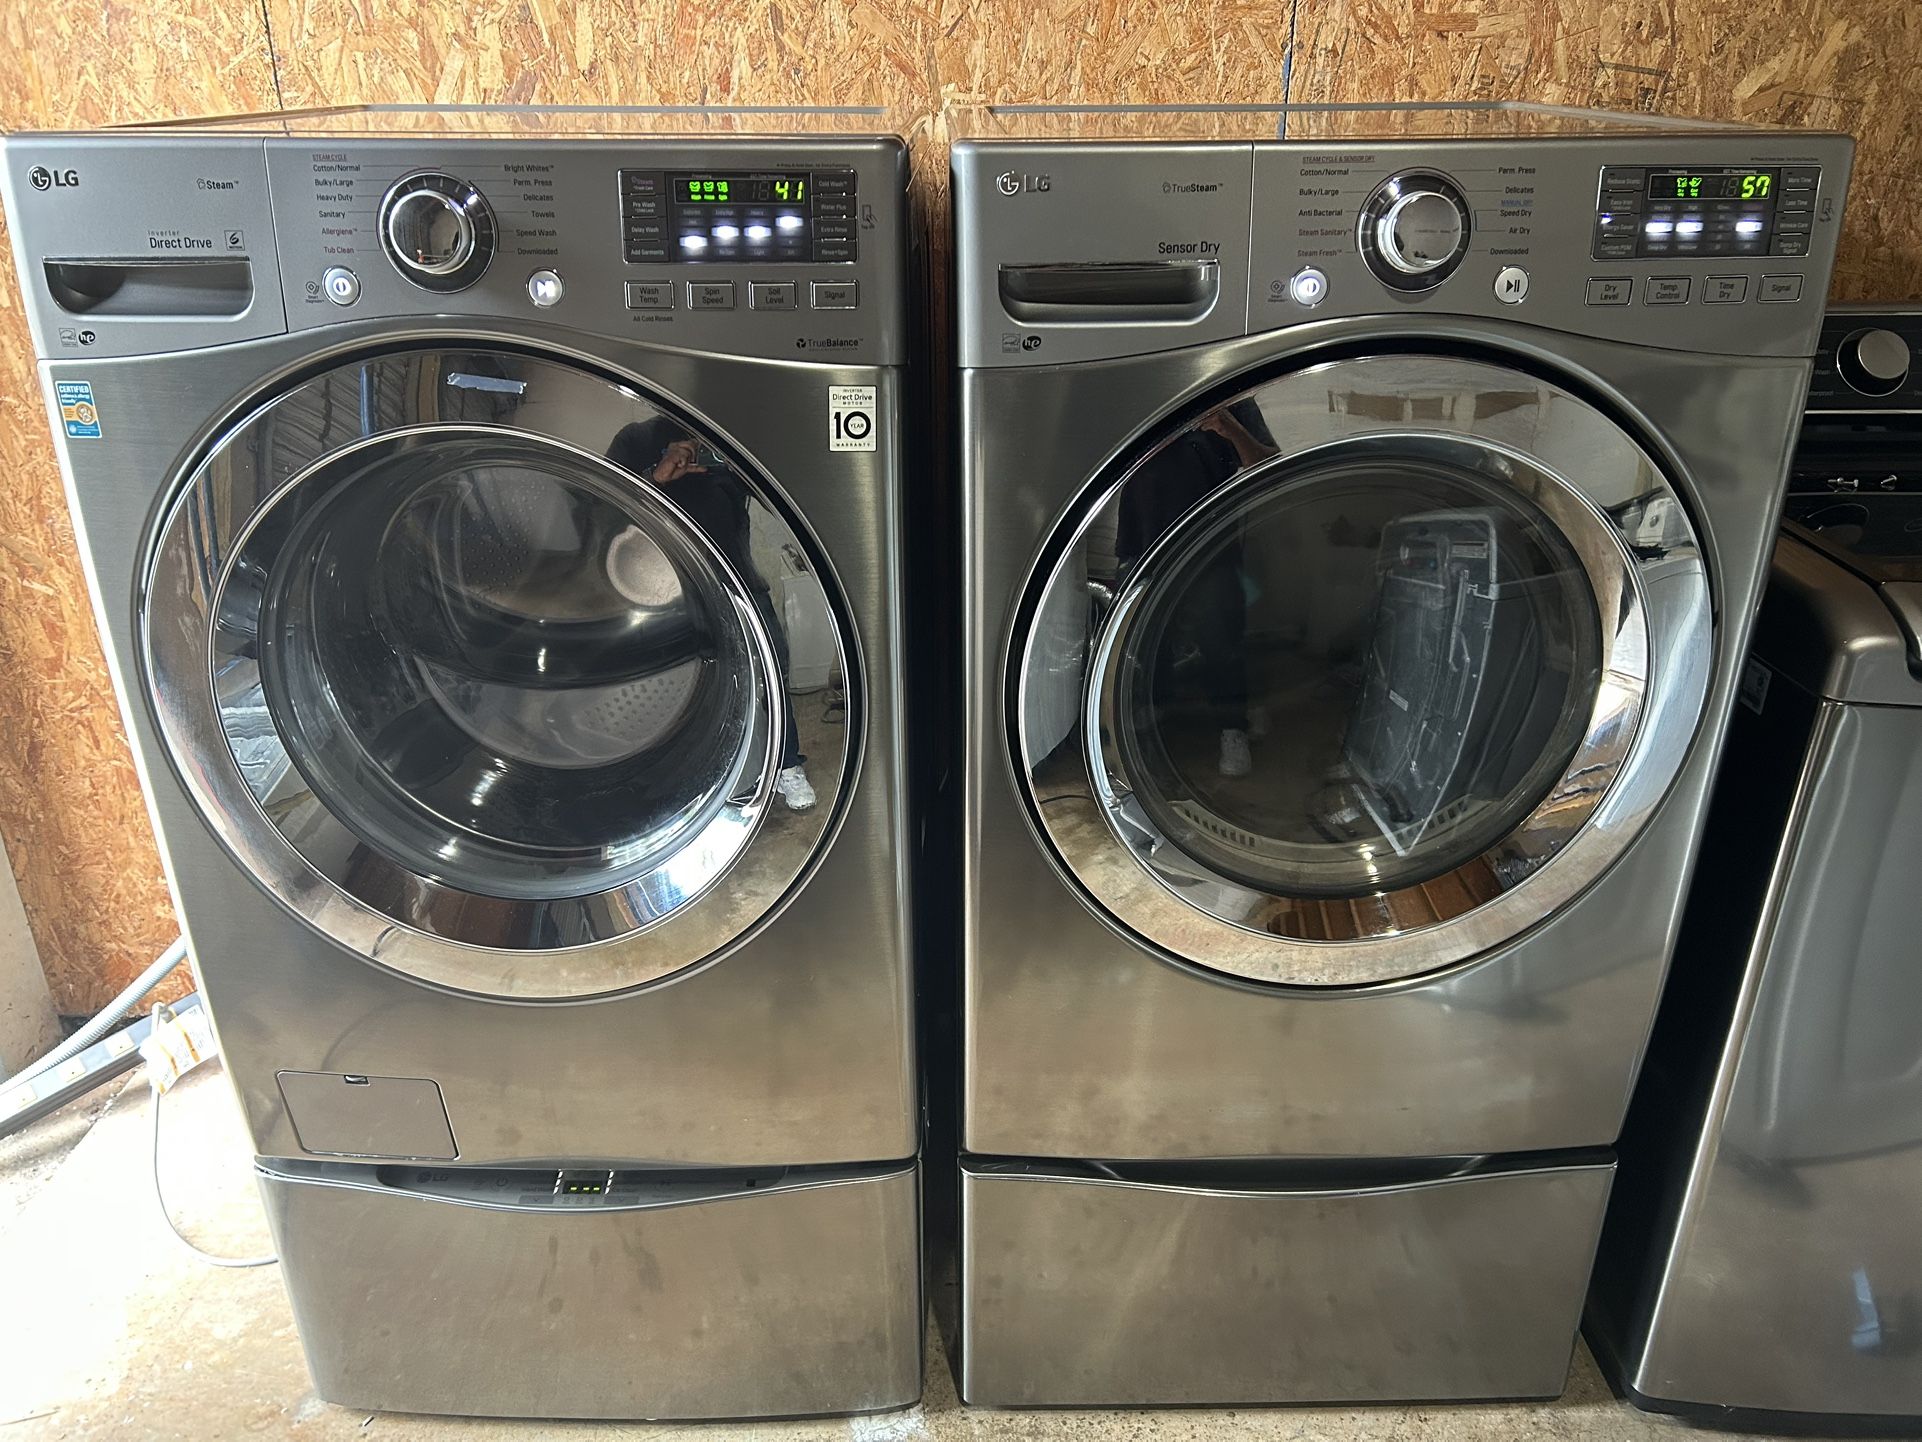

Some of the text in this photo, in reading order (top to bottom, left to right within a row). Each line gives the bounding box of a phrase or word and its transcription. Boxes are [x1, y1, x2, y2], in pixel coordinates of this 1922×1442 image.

[313, 164, 361, 173] Cotton/Normal
[504, 164, 524, 173] Bright
[1300, 168, 1349, 176] Cotton/Normal
[54, 169, 80, 187] LG
[315, 178, 354, 187] Bulky/Large
[533, 178, 553, 187] Press
[1024, 175, 1051, 192] LG
[1741, 175, 1771, 198] 57
[775, 181, 803, 200] 41
[1299, 188, 1340, 196] Bulky/Large
[1505, 186, 1534, 194] Delicates
[316, 193, 353, 202] Heavy Duty
[523, 194, 554, 202] Delicates
[318, 210, 346, 219] Sanitary
[531, 210, 556, 218] Towels
[1500, 209, 1532, 218] Speed Dry
[516, 229, 557, 238] Speed Wash
[1298, 229, 1319, 237] Steam
[1519, 227, 1531, 236] Dry
[149, 237, 213, 249] Direct Drive
[323, 246, 355, 254] Tub Clean
[1158, 241, 1220, 255] Sensor Dry
[1490, 248, 1529, 256] Downloaded
[1297, 249, 1318, 257] Steam
[1605, 284, 1617, 293] Dry
[1660, 283, 1678, 292] Temp
[1719, 282, 1734, 290] Time
[1771, 283, 1792, 293] Signal
[639, 287, 659, 296] Wash
[704, 287, 720, 297] Spin
[767, 287, 781, 295] Soil
[824, 290, 846, 300] Signal
[1656, 291, 1680, 300] Control
[1719, 290, 1731, 299] Dry
[639, 295, 659, 305] Temp
[702, 295, 724, 305] Speed
[765, 295, 784, 304] Level
[1600, 292, 1619, 300] Level
[59, 385, 89, 393] CERTIFIED
[832, 393, 873, 401] Direct Drive
[834, 411, 871, 440] 10
